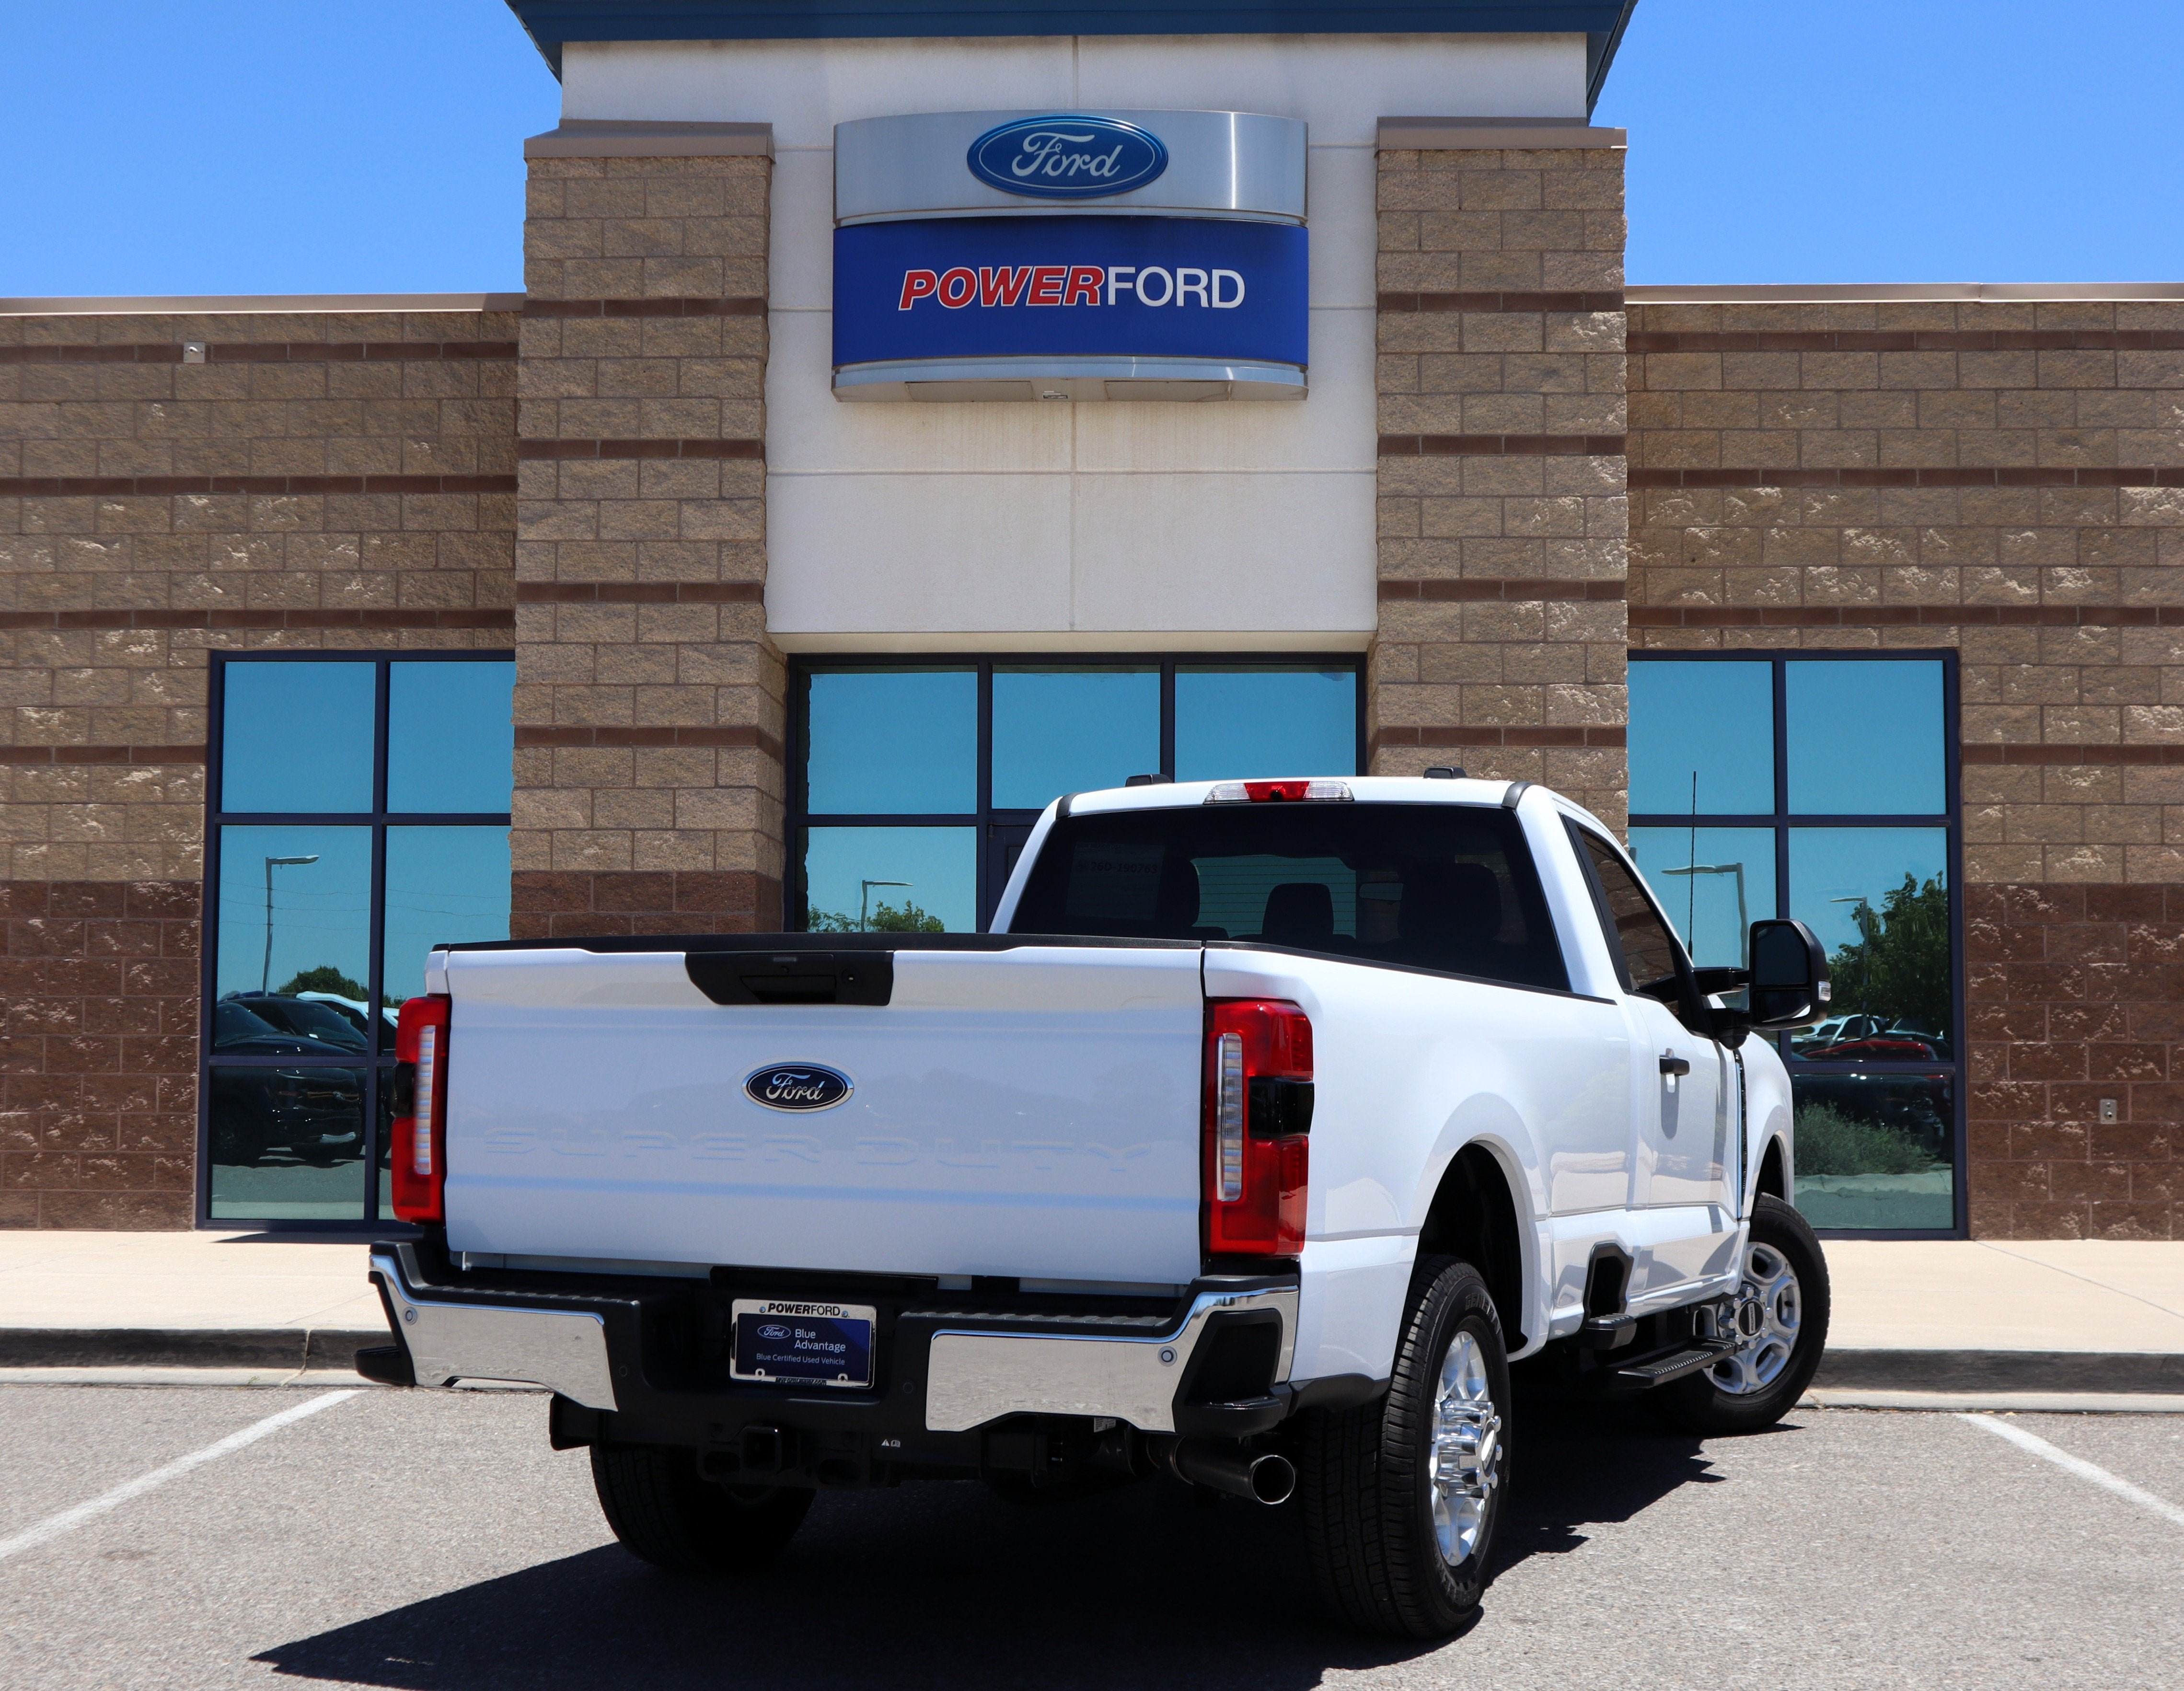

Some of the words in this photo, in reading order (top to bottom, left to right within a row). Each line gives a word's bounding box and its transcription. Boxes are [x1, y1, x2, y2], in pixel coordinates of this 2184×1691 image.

[1012, 132, 1123, 178] Ford
[898, 266, 1246, 311] POWERFORD
[766, 1073, 825, 1100] Ford
[484, 1127, 822, 1164] SUPER
[855, 1136, 1151, 1173] DUTY
[768, 1302, 841, 1316] POWERFORD
[763, 1326, 785, 1337] Ford
[795, 1329, 816, 1339] Blue
[794, 1340, 846, 1353] Advantage
[773, 1354, 801, 1363] Certified
[821, 1357, 845, 1366] Vehicle
